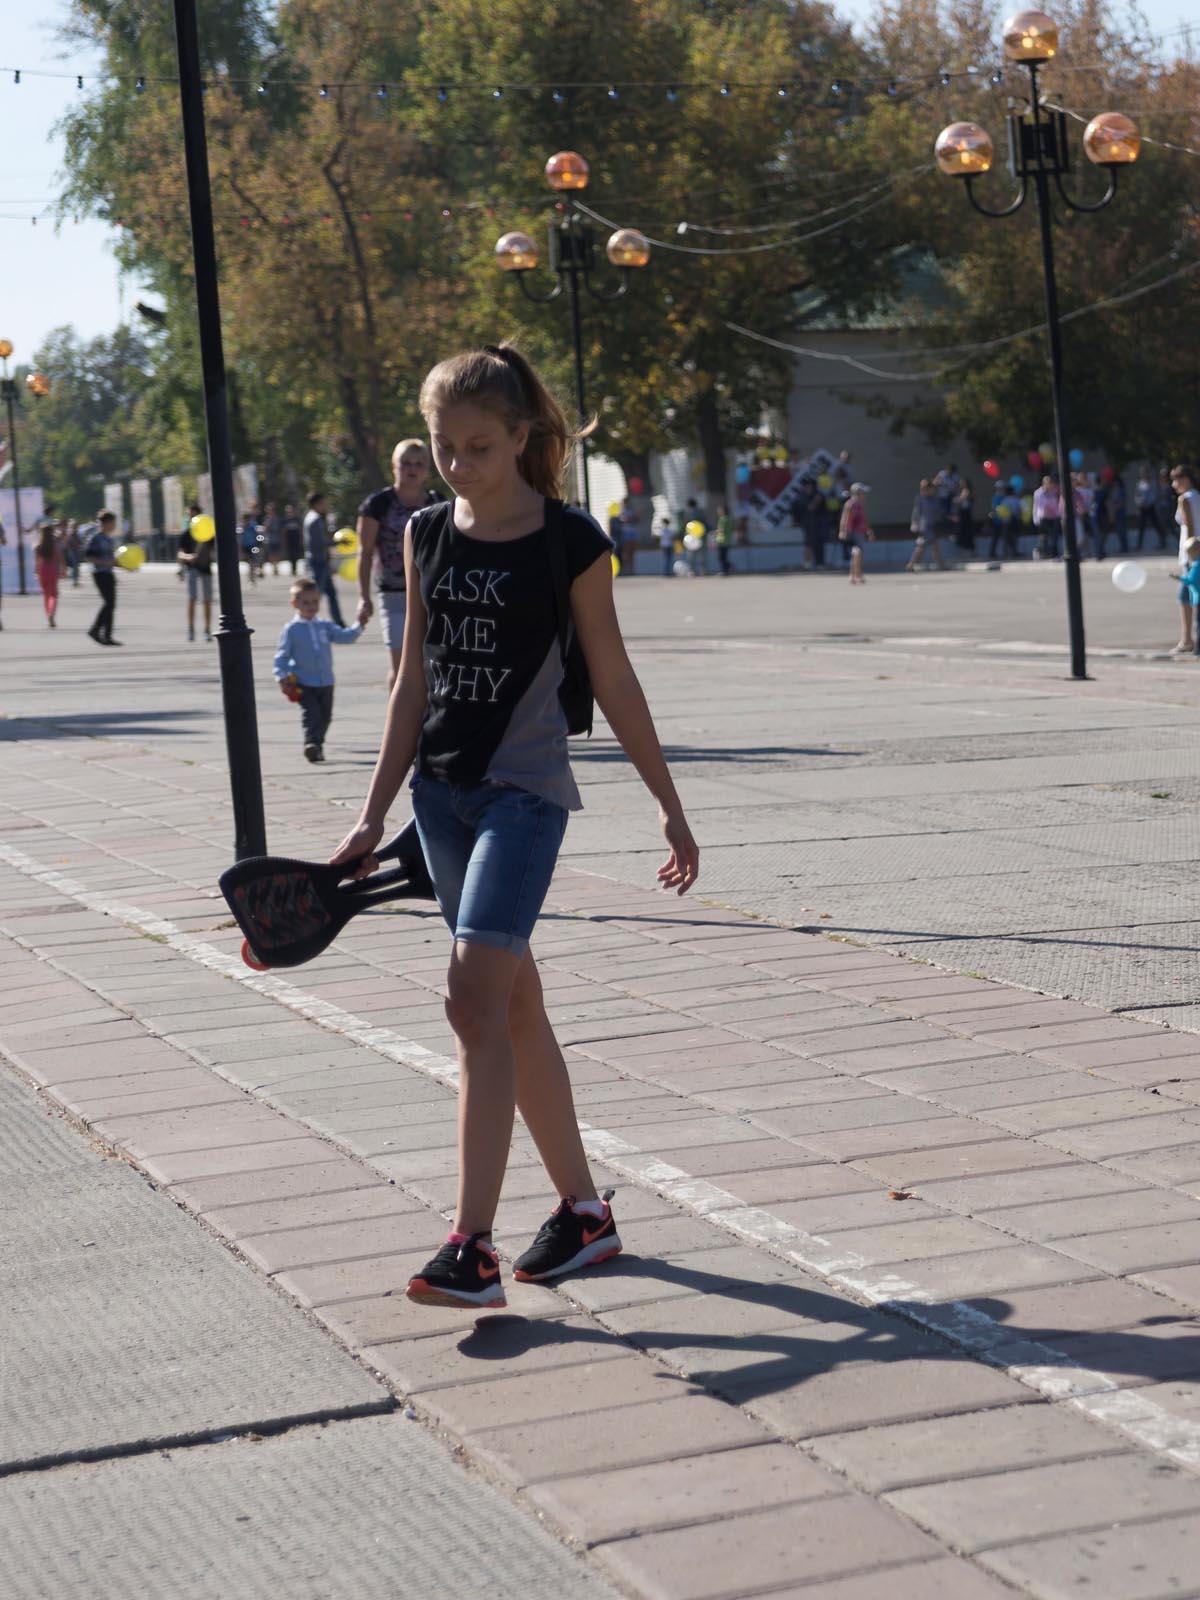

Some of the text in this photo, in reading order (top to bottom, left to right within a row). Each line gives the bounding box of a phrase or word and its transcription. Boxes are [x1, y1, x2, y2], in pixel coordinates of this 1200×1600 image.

[431, 566, 510, 606] ASK
[440, 614, 496, 653] ME
[429, 659, 512, 702] WHY
